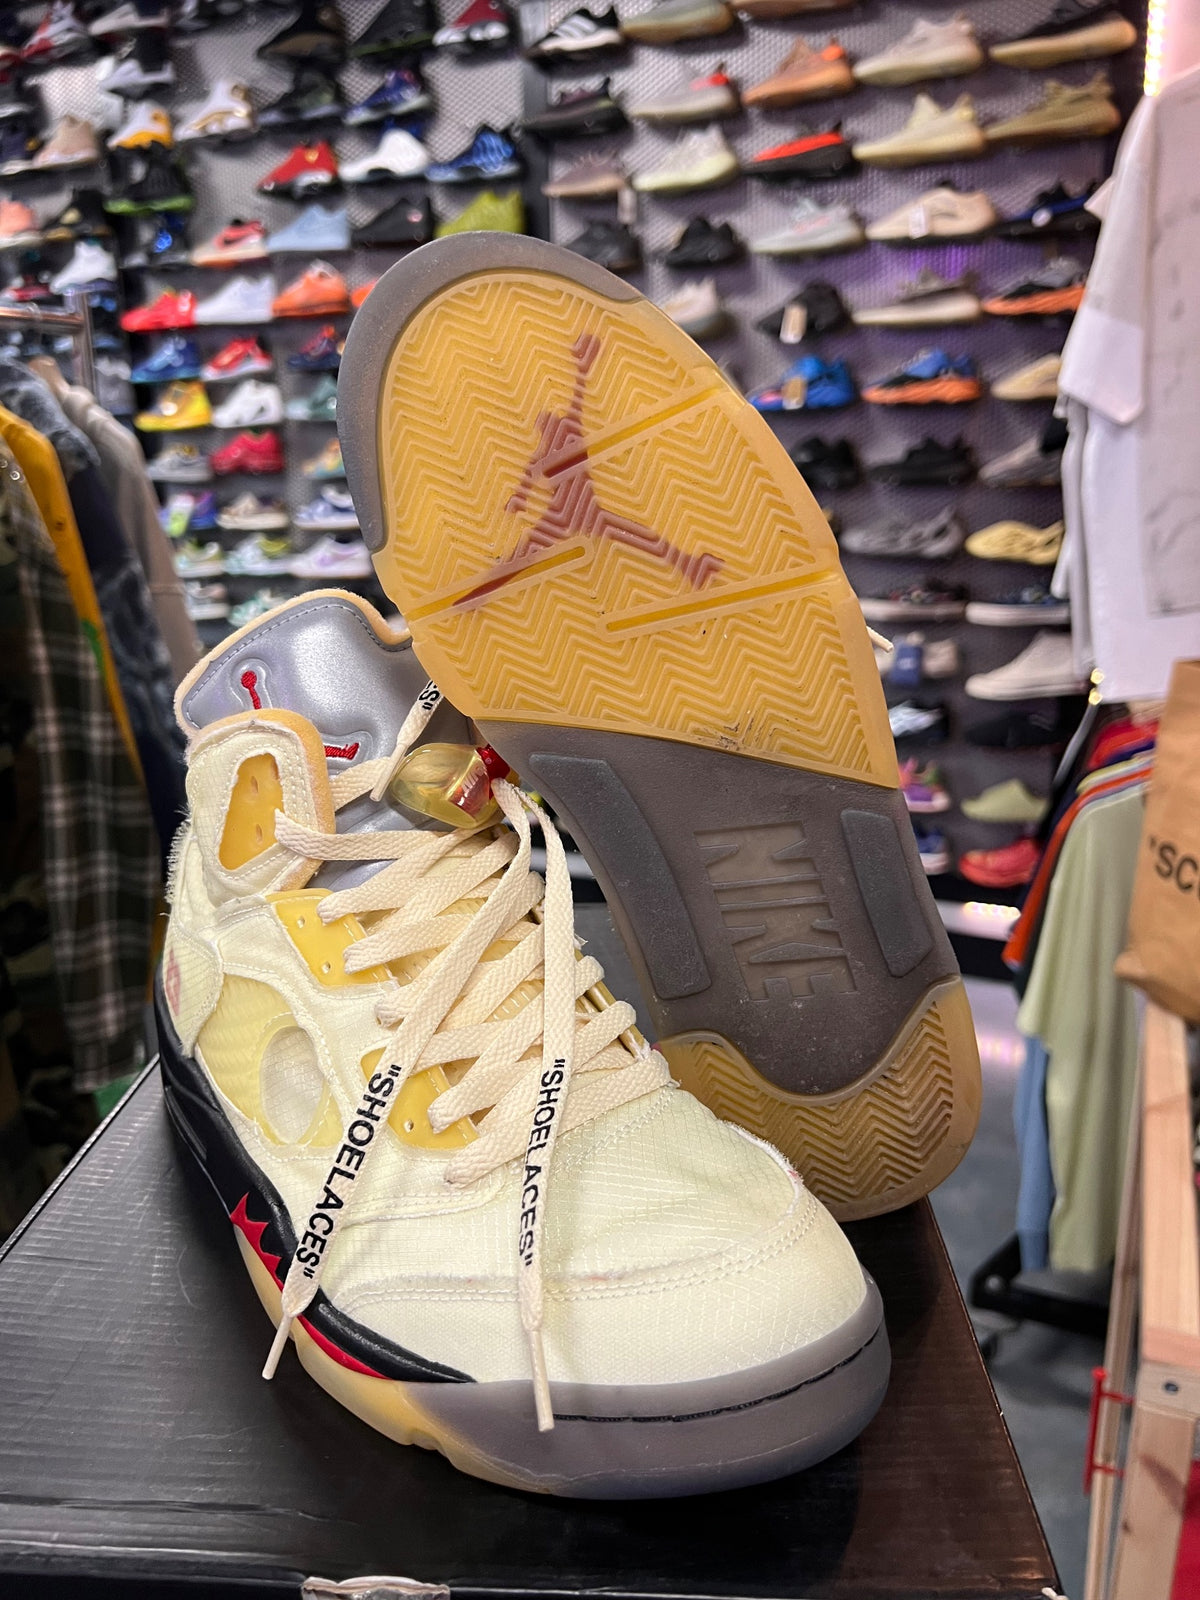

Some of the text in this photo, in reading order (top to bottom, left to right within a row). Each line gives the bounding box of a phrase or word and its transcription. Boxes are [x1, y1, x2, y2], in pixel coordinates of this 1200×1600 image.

[693, 821, 859, 1002] NIKE
[296, 1064, 402, 1279] "SHOELACES"
[518, 1058, 566, 1266] "SHOELACES"
